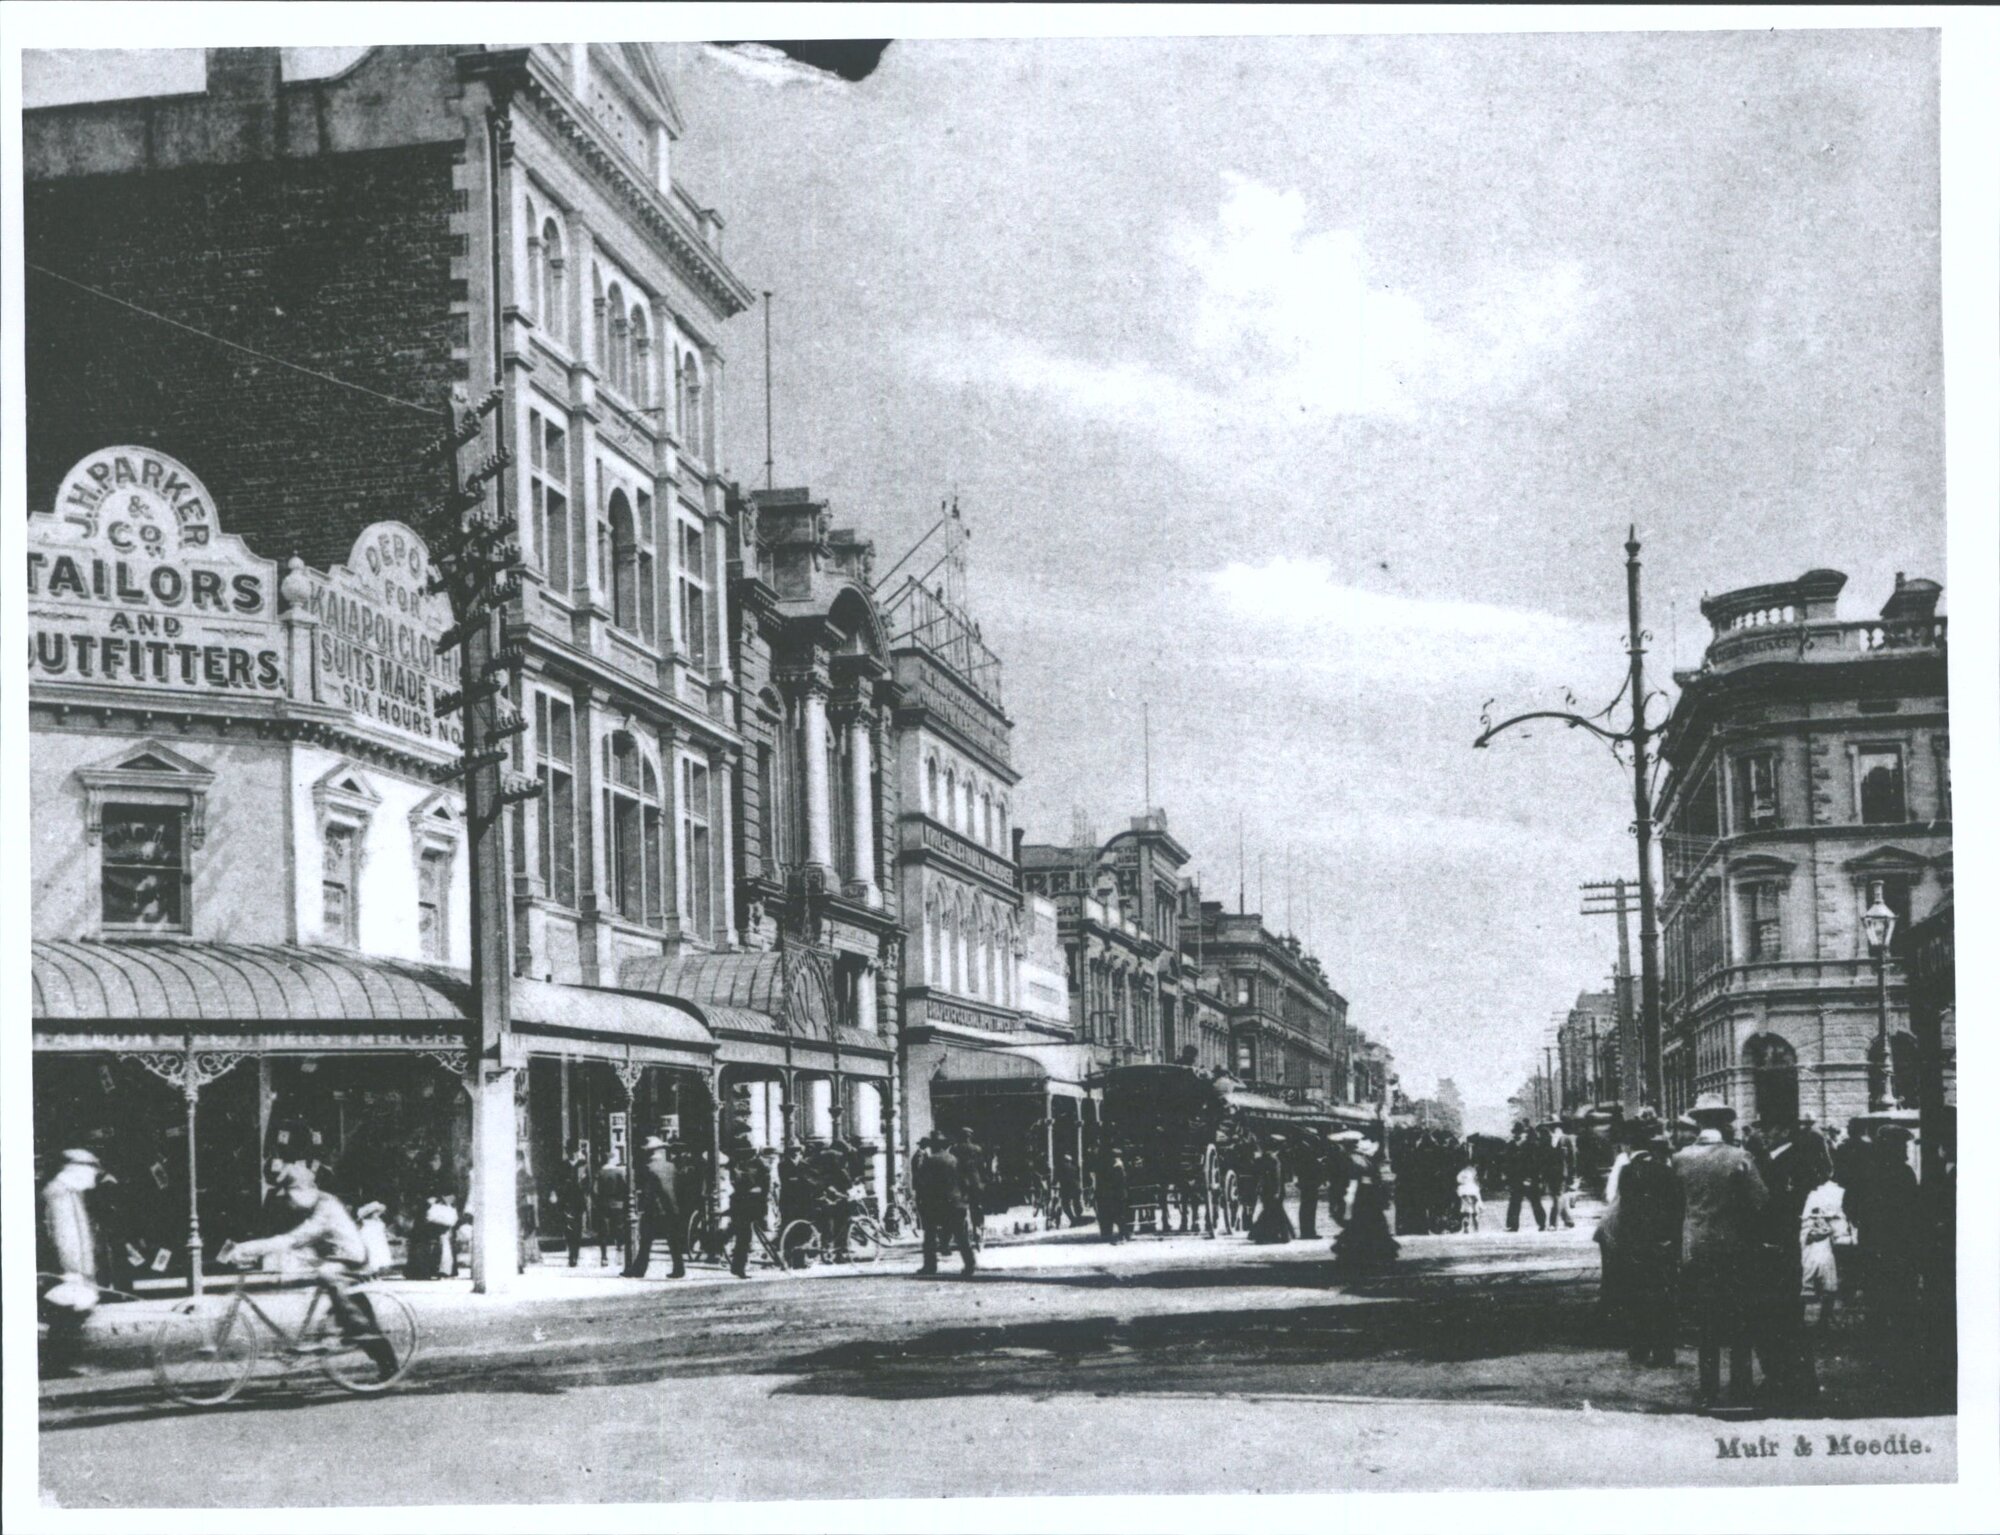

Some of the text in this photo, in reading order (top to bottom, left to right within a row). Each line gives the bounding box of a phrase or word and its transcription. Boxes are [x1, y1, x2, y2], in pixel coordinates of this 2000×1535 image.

[86, 456, 211, 547] PARKER
[127, 494, 152, 519] &
[27, 552, 264, 613] TAILORS
[385, 579, 421, 618] FOR
[110, 612, 182, 636] AND
[310, 580, 396, 657] KAIAPOI
[28, 631, 286, 689] UTFITTERS.
[321, 633, 376, 691] SUITS
[379, 657, 428, 712] MADE
[343, 684, 373, 717] SIX
[378, 697, 432, 736] HOURS
